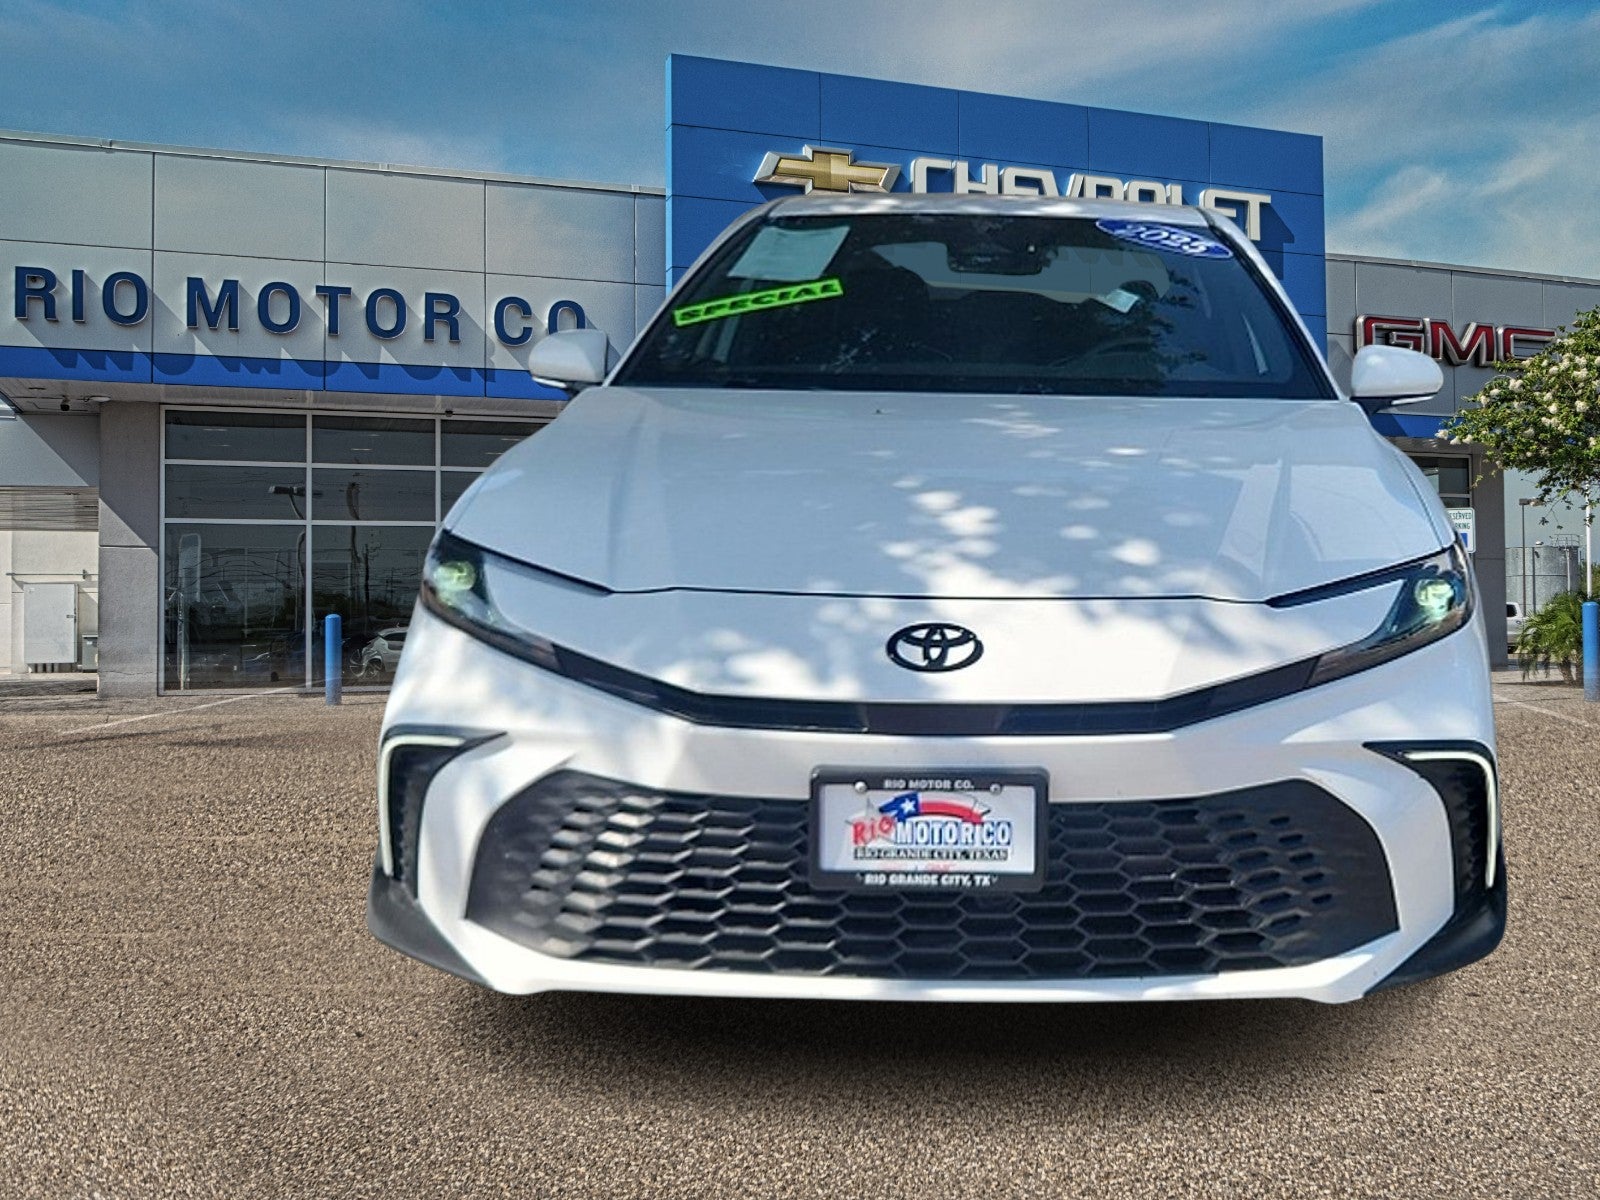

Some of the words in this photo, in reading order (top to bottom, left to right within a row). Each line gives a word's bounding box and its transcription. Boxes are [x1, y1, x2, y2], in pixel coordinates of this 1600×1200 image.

[14, 265, 149, 325] RIO
[186, 276, 461, 342] MOTOR
[493, 296, 587, 346] CO
[679, 282, 839, 321] SPECIAL
[1356, 314, 1557, 367] GMC
[884, 779, 906, 789] RIO
[908, 779, 951, 789] MOTOR
[954, 779, 975, 789] CO.
[880, 848, 932, 860] GRANDE
[969, 848, 1008, 860] TEXAS
[864, 873, 887, 885] RIO
[889, 873, 938, 885] GRANDE
[940, 873, 972, 887] CITY,
[975, 873, 991, 886] TX
